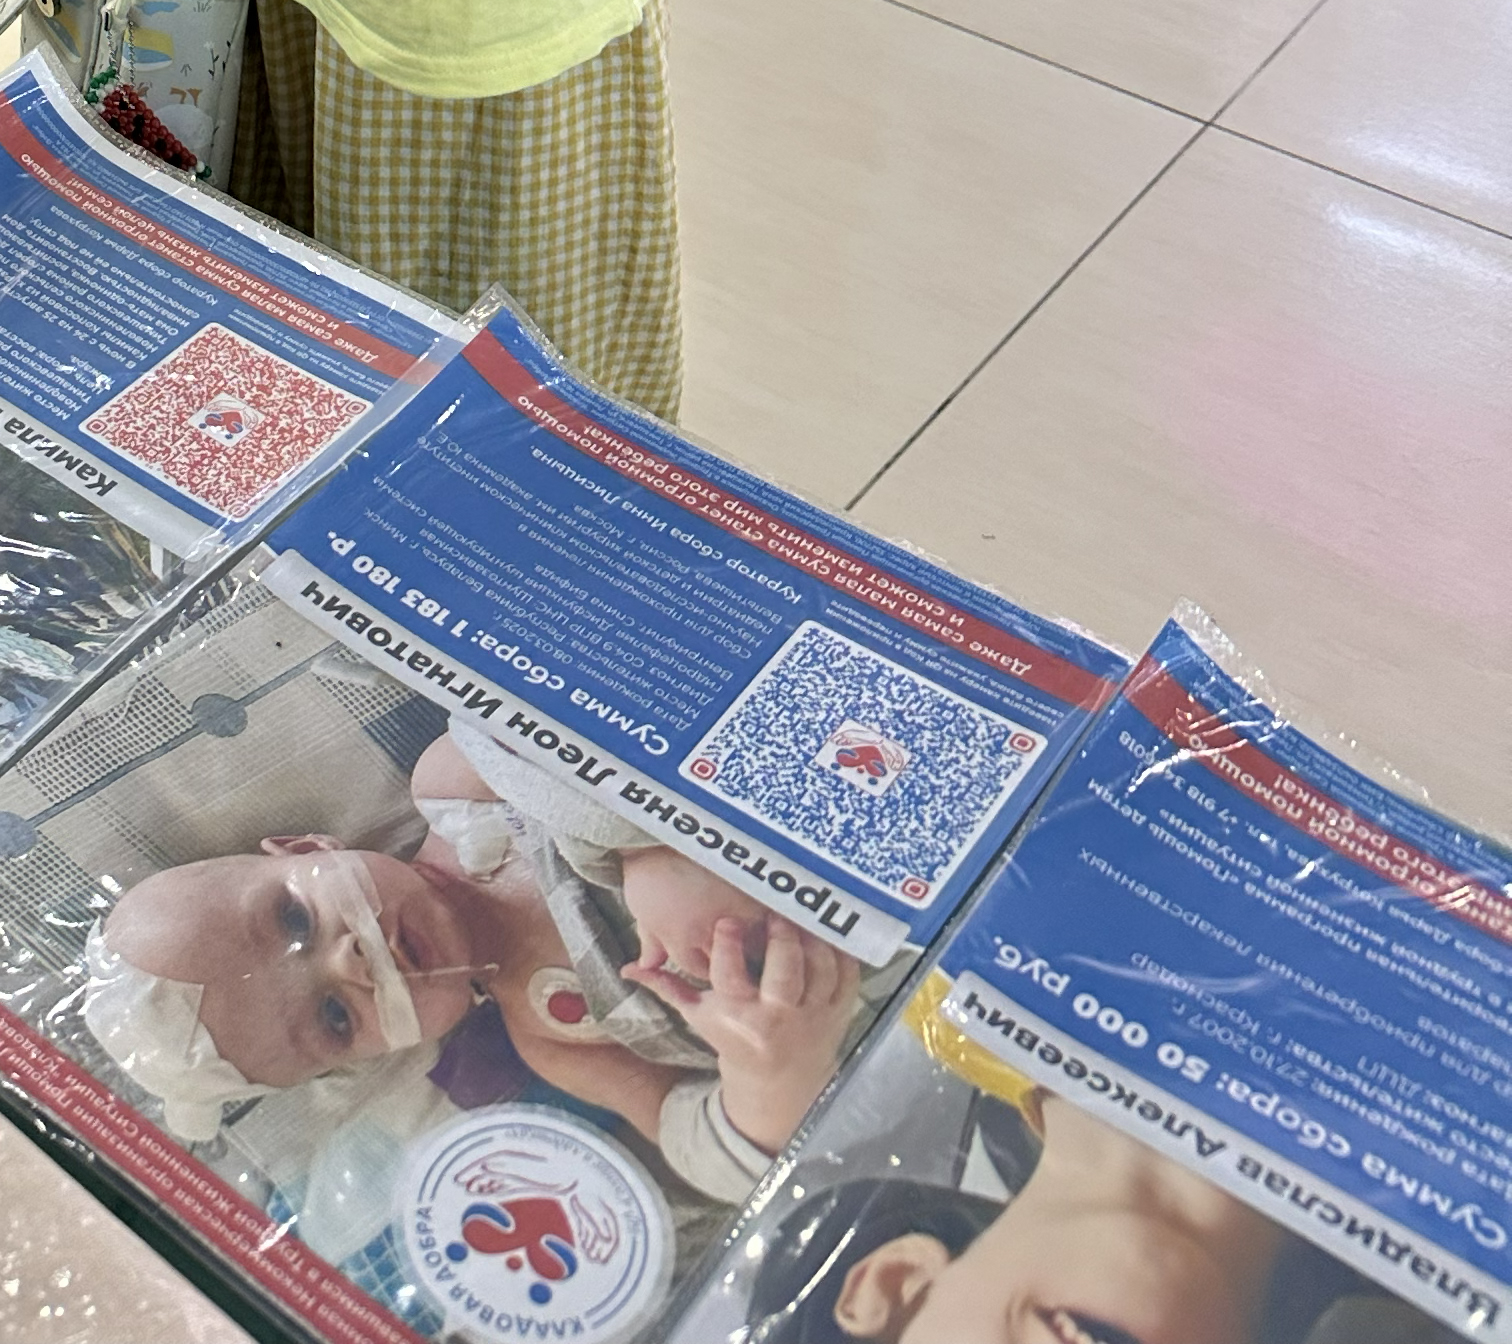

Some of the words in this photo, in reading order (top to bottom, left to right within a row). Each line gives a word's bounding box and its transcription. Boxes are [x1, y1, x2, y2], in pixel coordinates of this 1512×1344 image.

[19, 152, 84, 201] помощью
[66, 177, 114, 208] семьи!
[47, 204, 106, 240] Котрухова
[81, 199, 150, 241] огромной
[112, 204, 157, 232] целой
[7, 245, 48, 271] сгорел
[101, 236, 140, 260] Дарья
[148, 238, 196, 266] станет
[156, 229, 202, 256] жизнь
[44, 268, 89, 296] района
[135, 256, 173, 280] сбора
[195, 263, 243, 290] сумма
[202, 254, 270, 294] изменить
[0, 284, 45, 313] августа
[168, 275, 220, 307] Куратор
[241, 288, 287, 315] малая
[269, 292, 325, 324] сможет
[37, 294, 101, 334] Копосовой
[40, 310, 58, 322] 25
[56, 319, 74, 330] на
[84, 293, 168, 344] Тимашевского
[287, 313, 333, 339] самая
[325, 322, 338, 330] и
[71, 328, 89, 340] 24
[96, 342, 126, 362] ночь
[97, 330, 148, 362] Камилы
[332, 337, 378, 363] Даже
[7, 349, 93, 402] Тимашевского
[123, 360, 137, 369] В
[30, 393, 72, 419] Место
[514, 394, 603, 456] помощью
[580, 422, 669, 475] ребёнка!
[524, 443, 622, 504] Лисицына.
[601, 451, 698, 508] огромной
[668, 470, 721, 502] этого
[370, 474, 428, 518] системы.
[620, 499, 668, 530] Инна
[722, 497, 766, 524] мир
[360, 507, 407, 544] Минск.
[568, 502, 625, 538] Москва.
[623, 533, 637, 543] г.
[697, 503, 765, 541] станет
[322, 528, 356, 557] р.
[405, 539, 419, 550] г.
[425, 513, 526, 580] шунтирующей
[633, 538, 692, 575] Россия,
[668, 524, 726, 561] сбора
[765, 520, 864, 575] изменить
[766, 536, 834, 574] сумма
[350, 554, 401, 593] 180
[415, 545, 485, 593] Беларусь,
[416, 527, 535, 603] Шунтозависимая
[530, 561, 590, 600] Бифида.
[723, 555, 802, 602] Куратор
[401, 588, 451, 624] 183
[522, 574, 614, 632] Дисфункция
[688, 568, 784, 626] Вельтищева,
[833, 571, 899, 608] малая
[866, 572, 947, 616] сможет
[451, 619, 470, 636] 1
[482, 587, 568, 642] Республика
[490, 610, 502, 620] г.
[531, 596, 571, 624] ЦНС.
[587, 596, 636, 628] Спина
[900, 605, 967, 642] самая
[948, 613, 966, 625] и
[294, 577, 503, 721] Игнатович
[500, 617, 574, 664] 08.03.2025
[568, 620, 603, 644] ВПР
[466, 623, 570, 695] сбора:
[564, 636, 653, 690] жительства:
[601, 639, 646, 668] G04.9
[610, 625, 724, 694] гидроцефалия.
[633, 622, 734, 683] Вентрикулит.
[966, 638, 1032, 676] Даже
[572, 657, 654, 708] рождения:
[643, 662, 714, 707] Диагноз:
[565, 685, 676, 757] Сумма
[651, 687, 700, 720] Место
[651, 704, 692, 732] Дата
[499, 711, 616, 791] Леон
[613, 775, 866, 938] Протасеня
[984, 931, 1070, 1000] руб.
[1069, 989, 1151, 1050] 000
[1167, 997, 1187, 1014] г.
[1153, 1039, 1209, 1083] 50
[1188, 1009, 1307, 1085] 27.10.2007
[958, 992, 1225, 1165] Алексеевич
[1208, 1066, 1356, 1164] сбора:
[1307, 1073, 1455, 1165] рождения:
[1355, 1142, 1512, 1254] Сумма
[417, 1205, 454, 1283] ДОБРА
[445, 1283, 582, 1344] КЛАДОВАЯ
